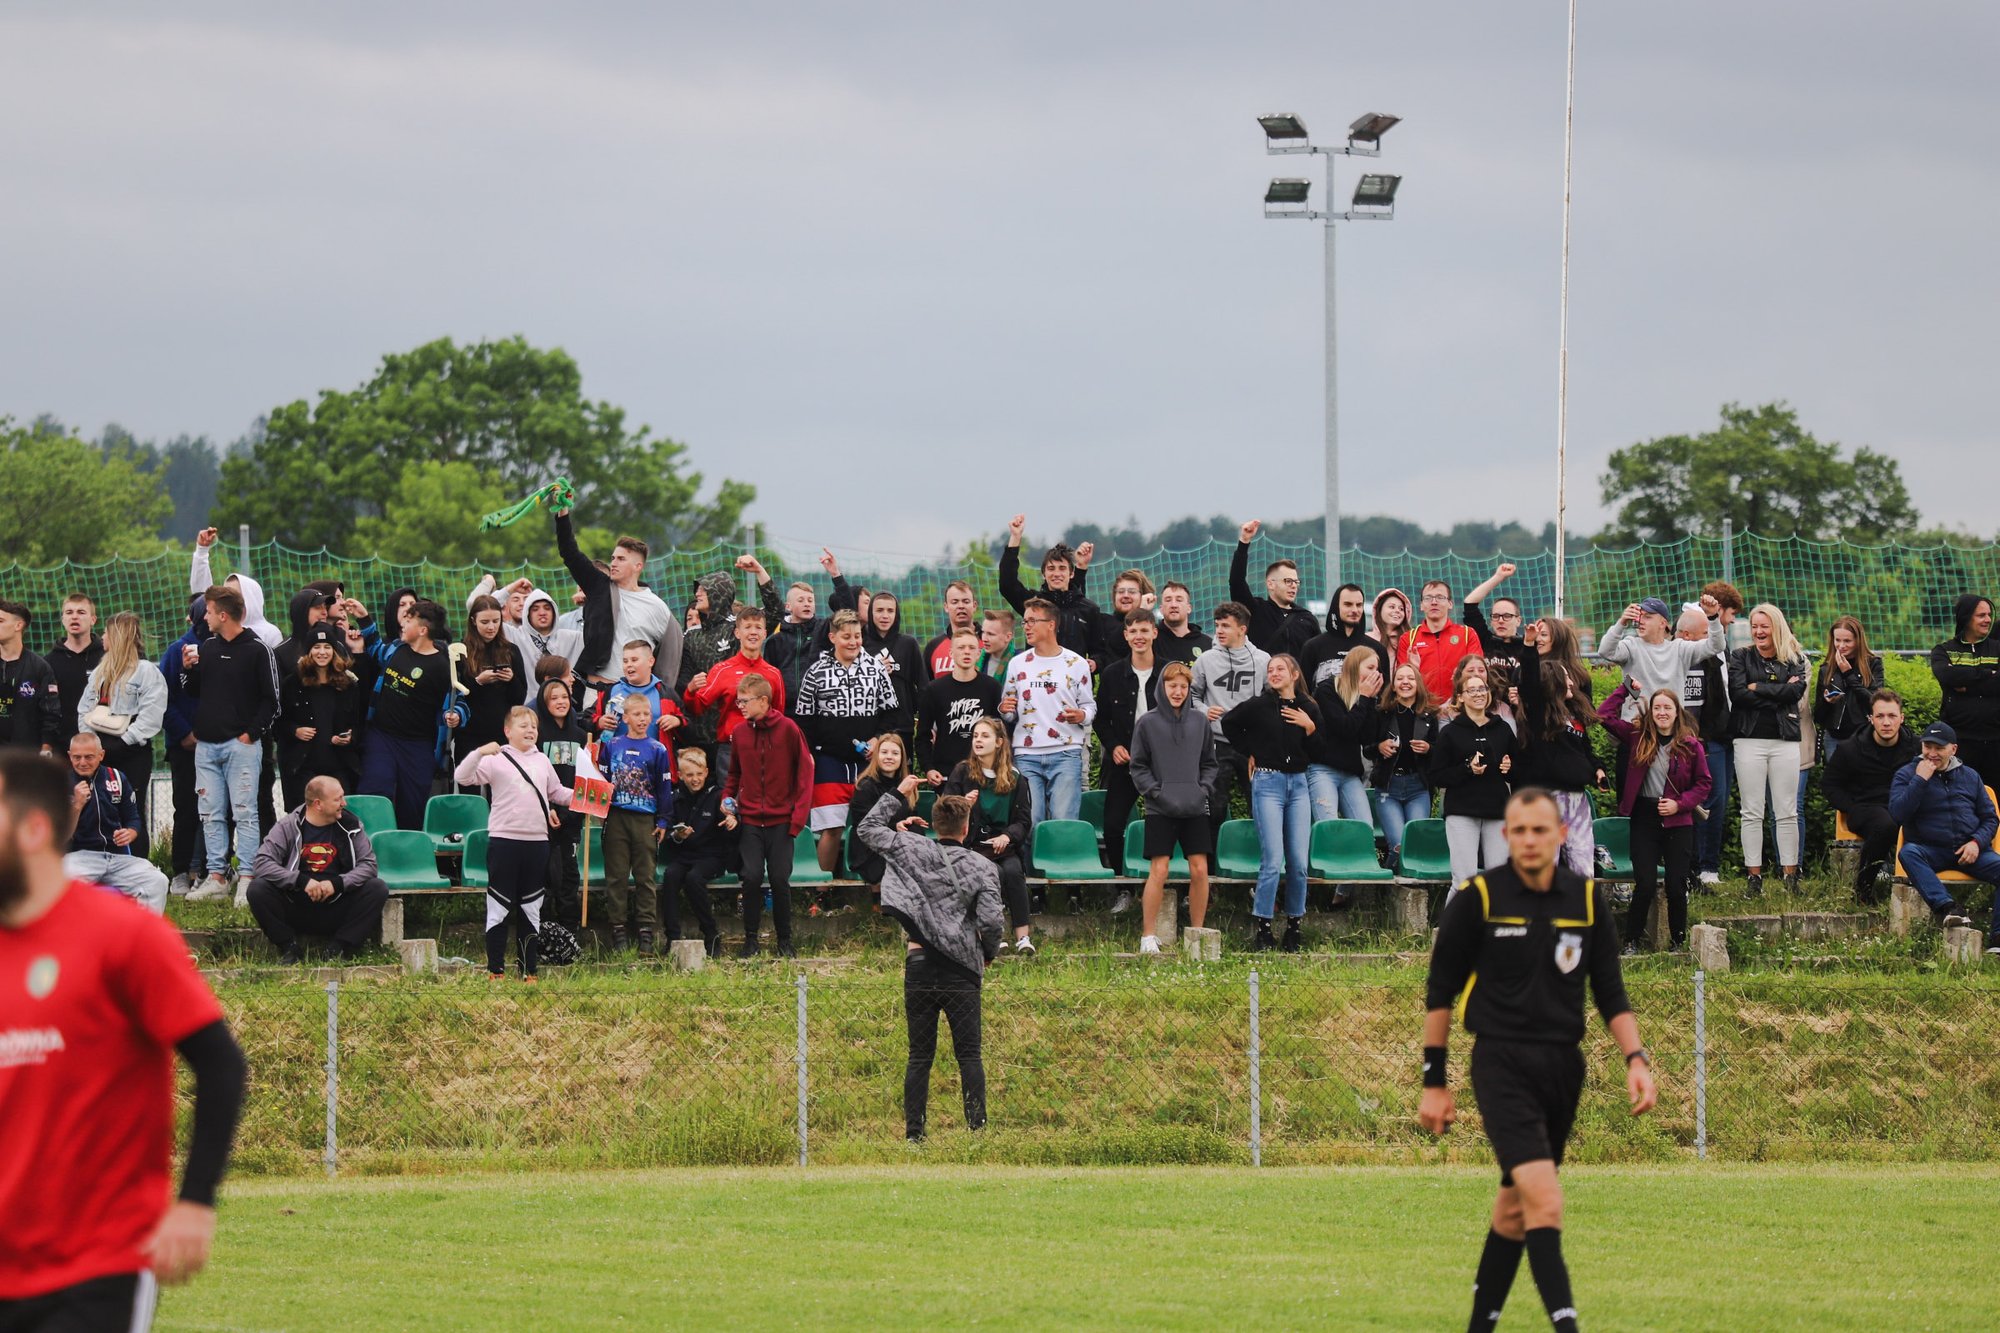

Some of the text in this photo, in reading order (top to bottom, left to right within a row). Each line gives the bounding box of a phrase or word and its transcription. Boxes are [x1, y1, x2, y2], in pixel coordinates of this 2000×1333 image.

[1030, 681, 1058, 689] FIERCE
[1213, 670, 1255, 692] 4F
[946, 697, 981, 719] AFTER
[948, 708, 985, 735] DARK
[105, 780, 120, 791] 98
